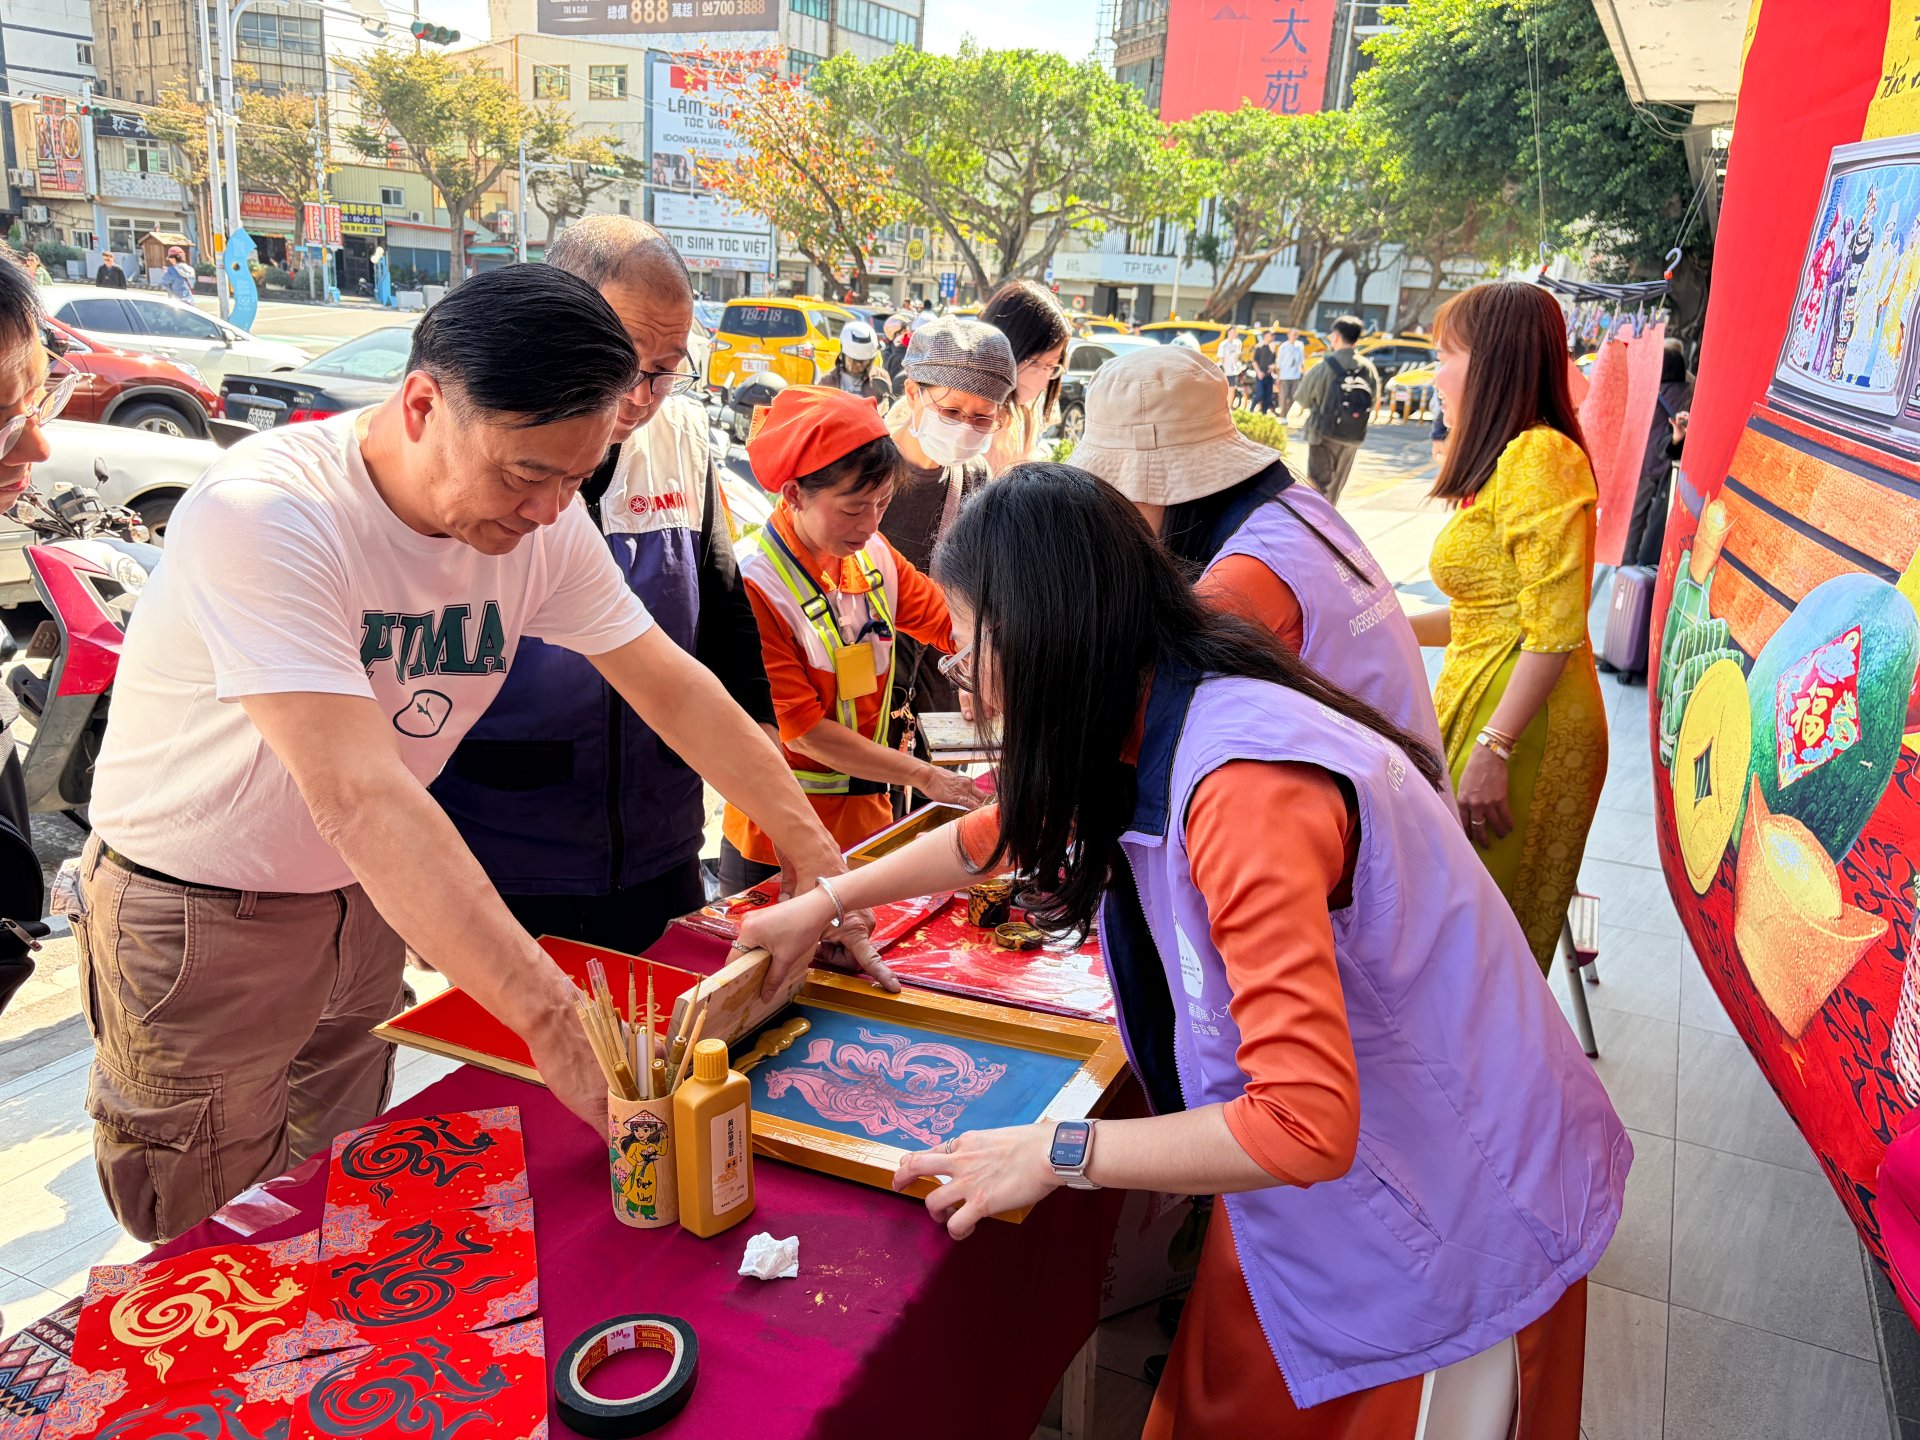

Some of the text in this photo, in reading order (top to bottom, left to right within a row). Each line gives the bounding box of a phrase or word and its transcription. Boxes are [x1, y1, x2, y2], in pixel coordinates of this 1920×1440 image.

[607, 5, 628, 20] 總價
[631, 0, 669, 24] 888
[672, 3, 693, 18] 萬起
[668, 96, 702, 114] LÂM
[687, 236, 714, 251] SINH
[718, 236, 739, 253] TÓC
[743, 238, 767, 256] VIỆT
[1791, 677, 1834, 748] 福
[610, 1329, 624, 1340] 3M
